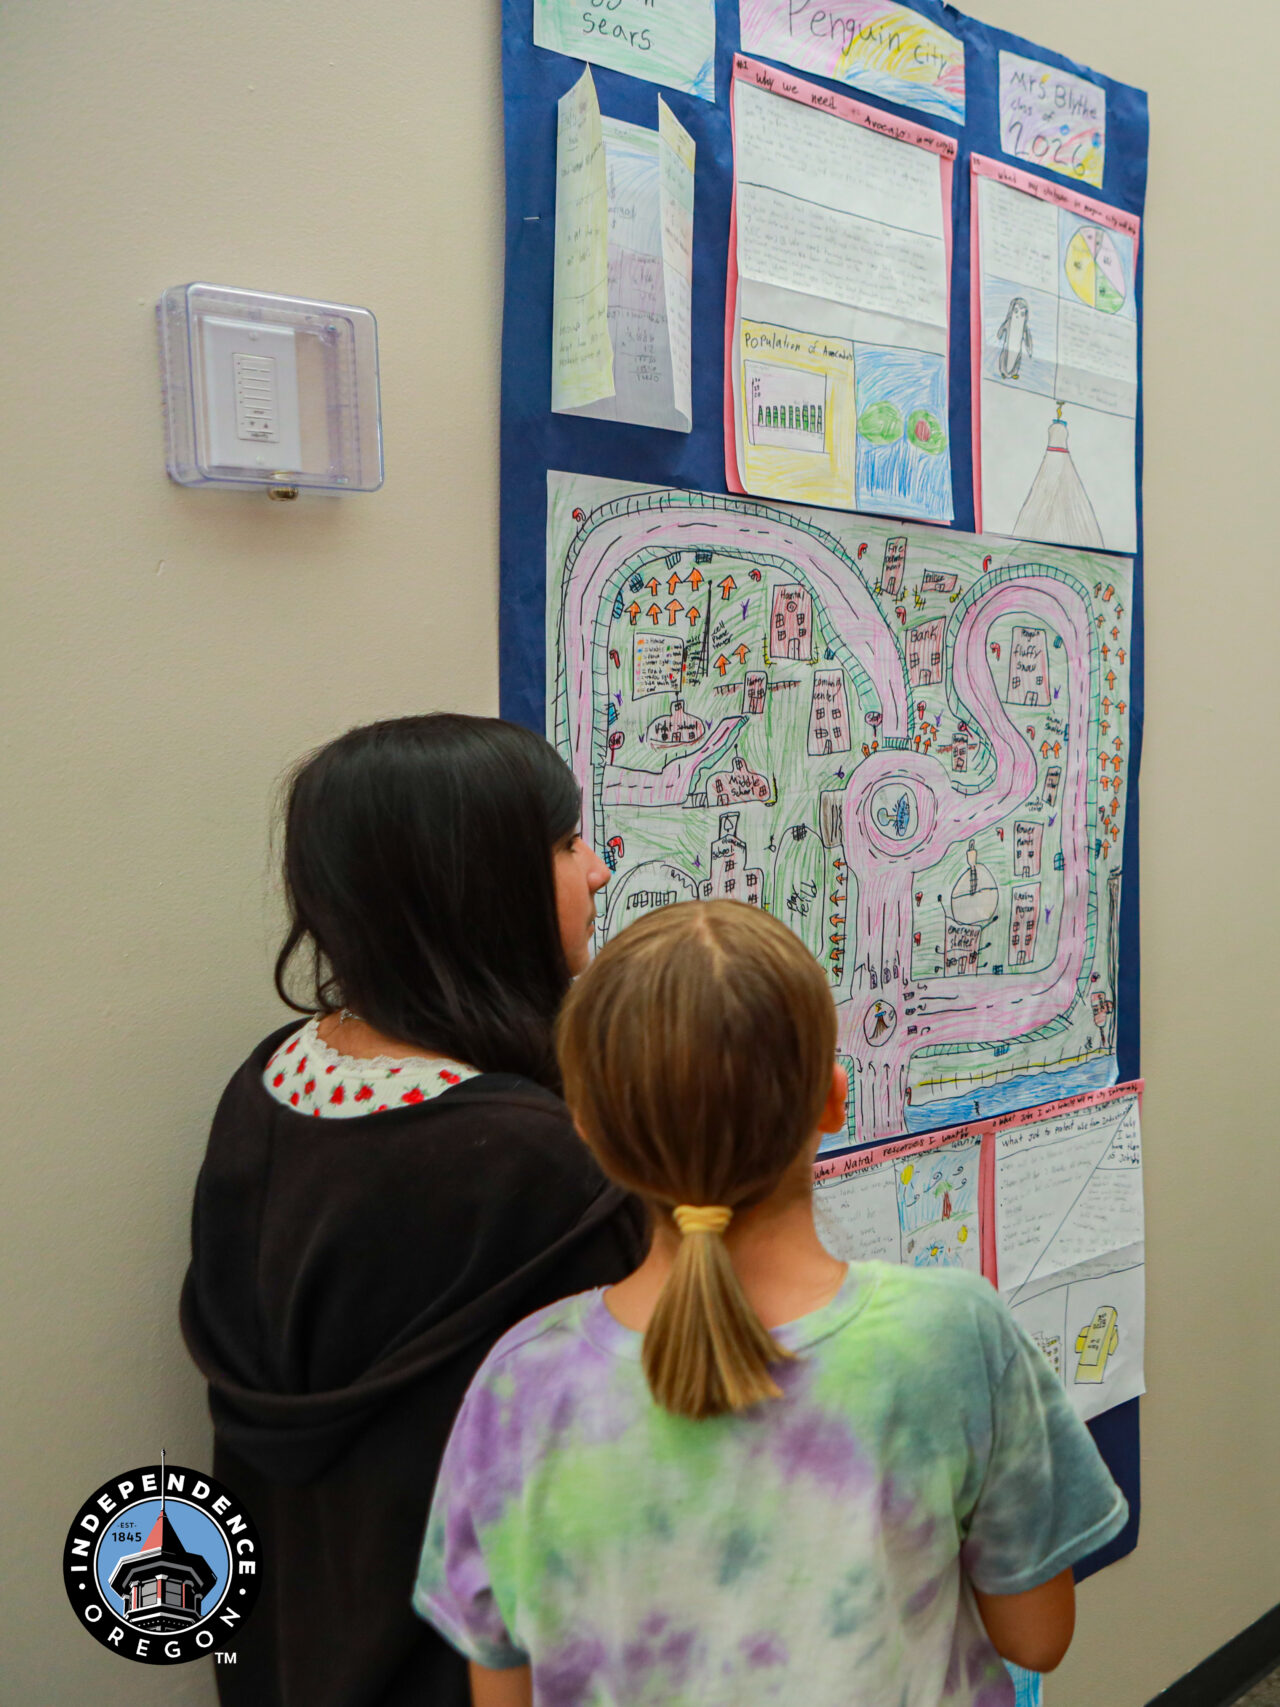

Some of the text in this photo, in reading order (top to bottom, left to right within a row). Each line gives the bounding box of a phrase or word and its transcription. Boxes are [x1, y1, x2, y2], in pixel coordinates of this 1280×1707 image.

[811, 93, 838, 110] need
[1054, 84, 1097, 120] Blythe
[1008, 121, 1086, 177] 2026
[911, 625, 938, 643] Bank
